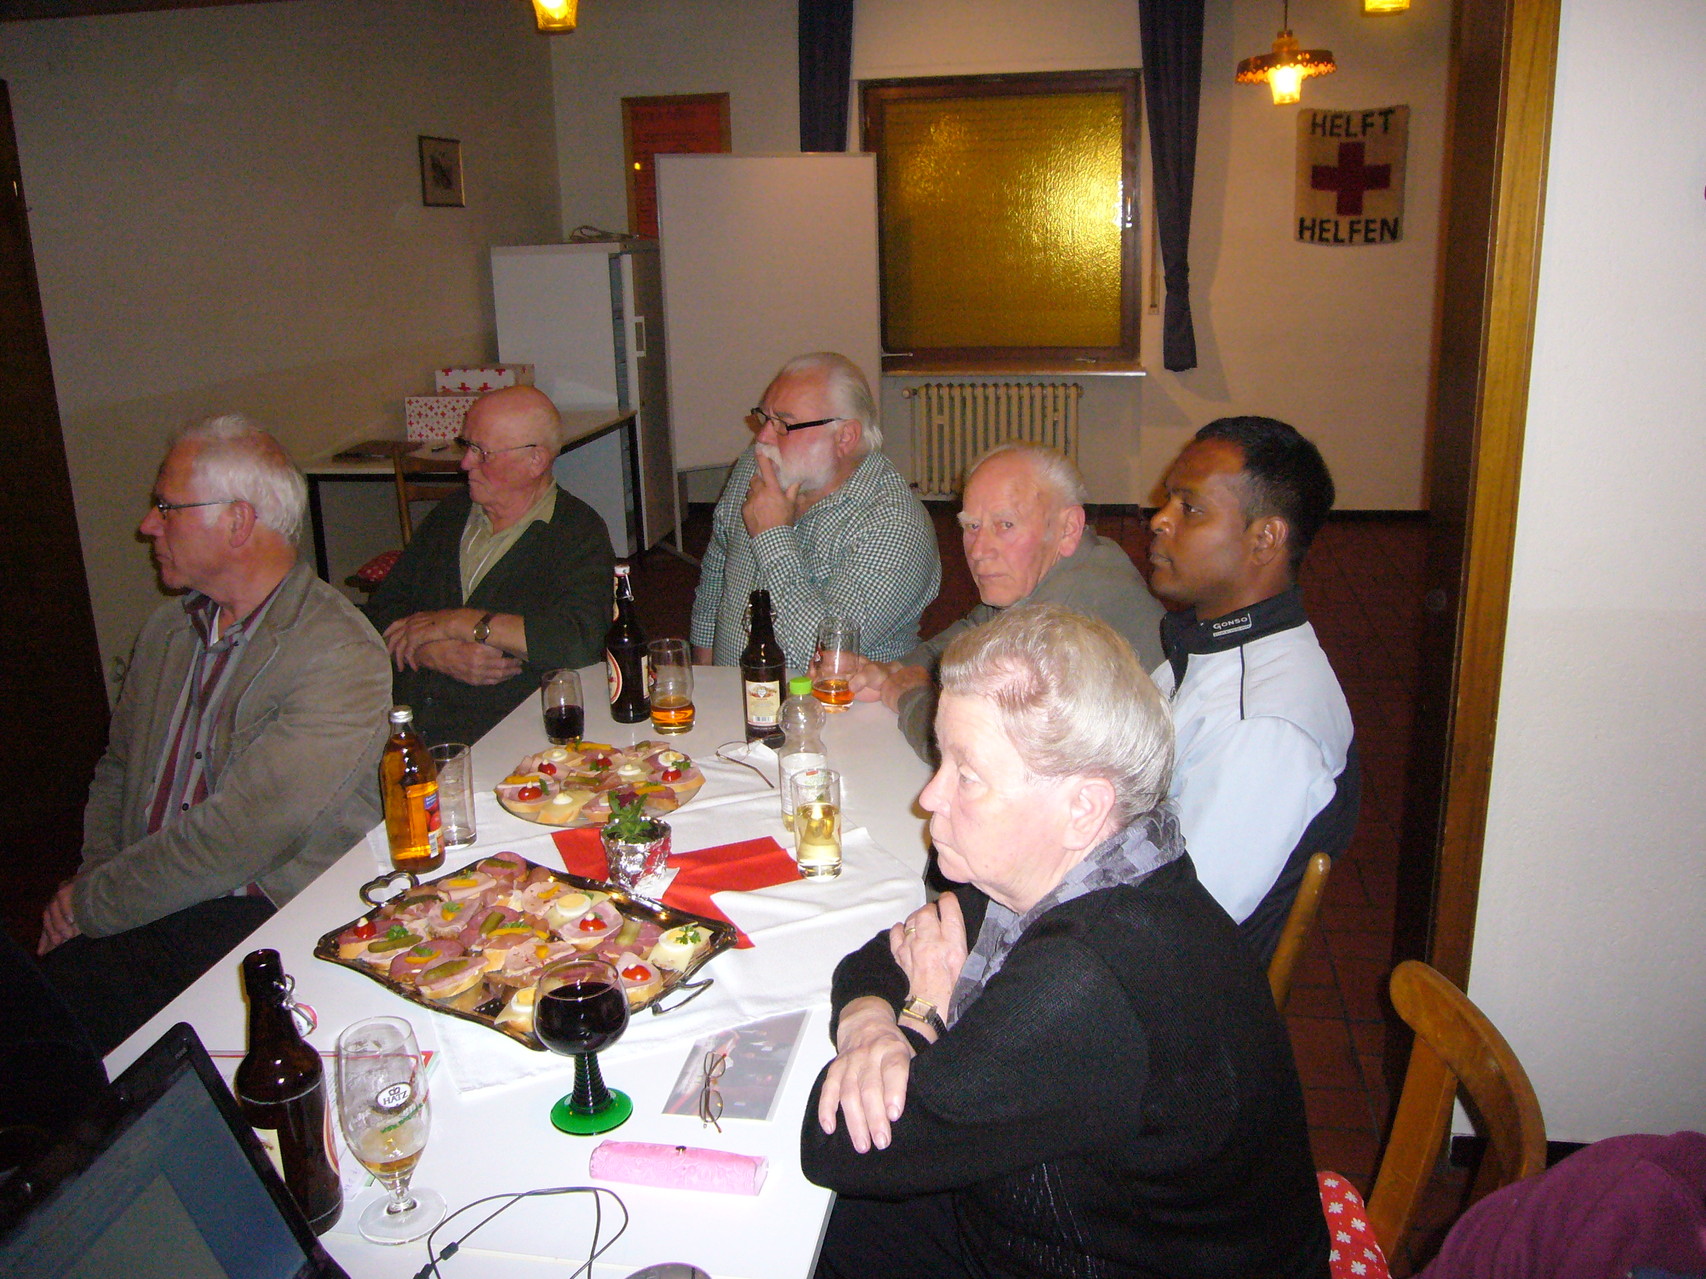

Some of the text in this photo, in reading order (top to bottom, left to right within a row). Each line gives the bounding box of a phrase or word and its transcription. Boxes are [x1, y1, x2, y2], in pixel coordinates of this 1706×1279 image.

[1311, 109, 1395, 137] HELFT
[1298, 217, 1399, 243] HELFEN
[1213, 617, 1248, 629] GONSO
[383, 1090, 408, 1105] HATZ
